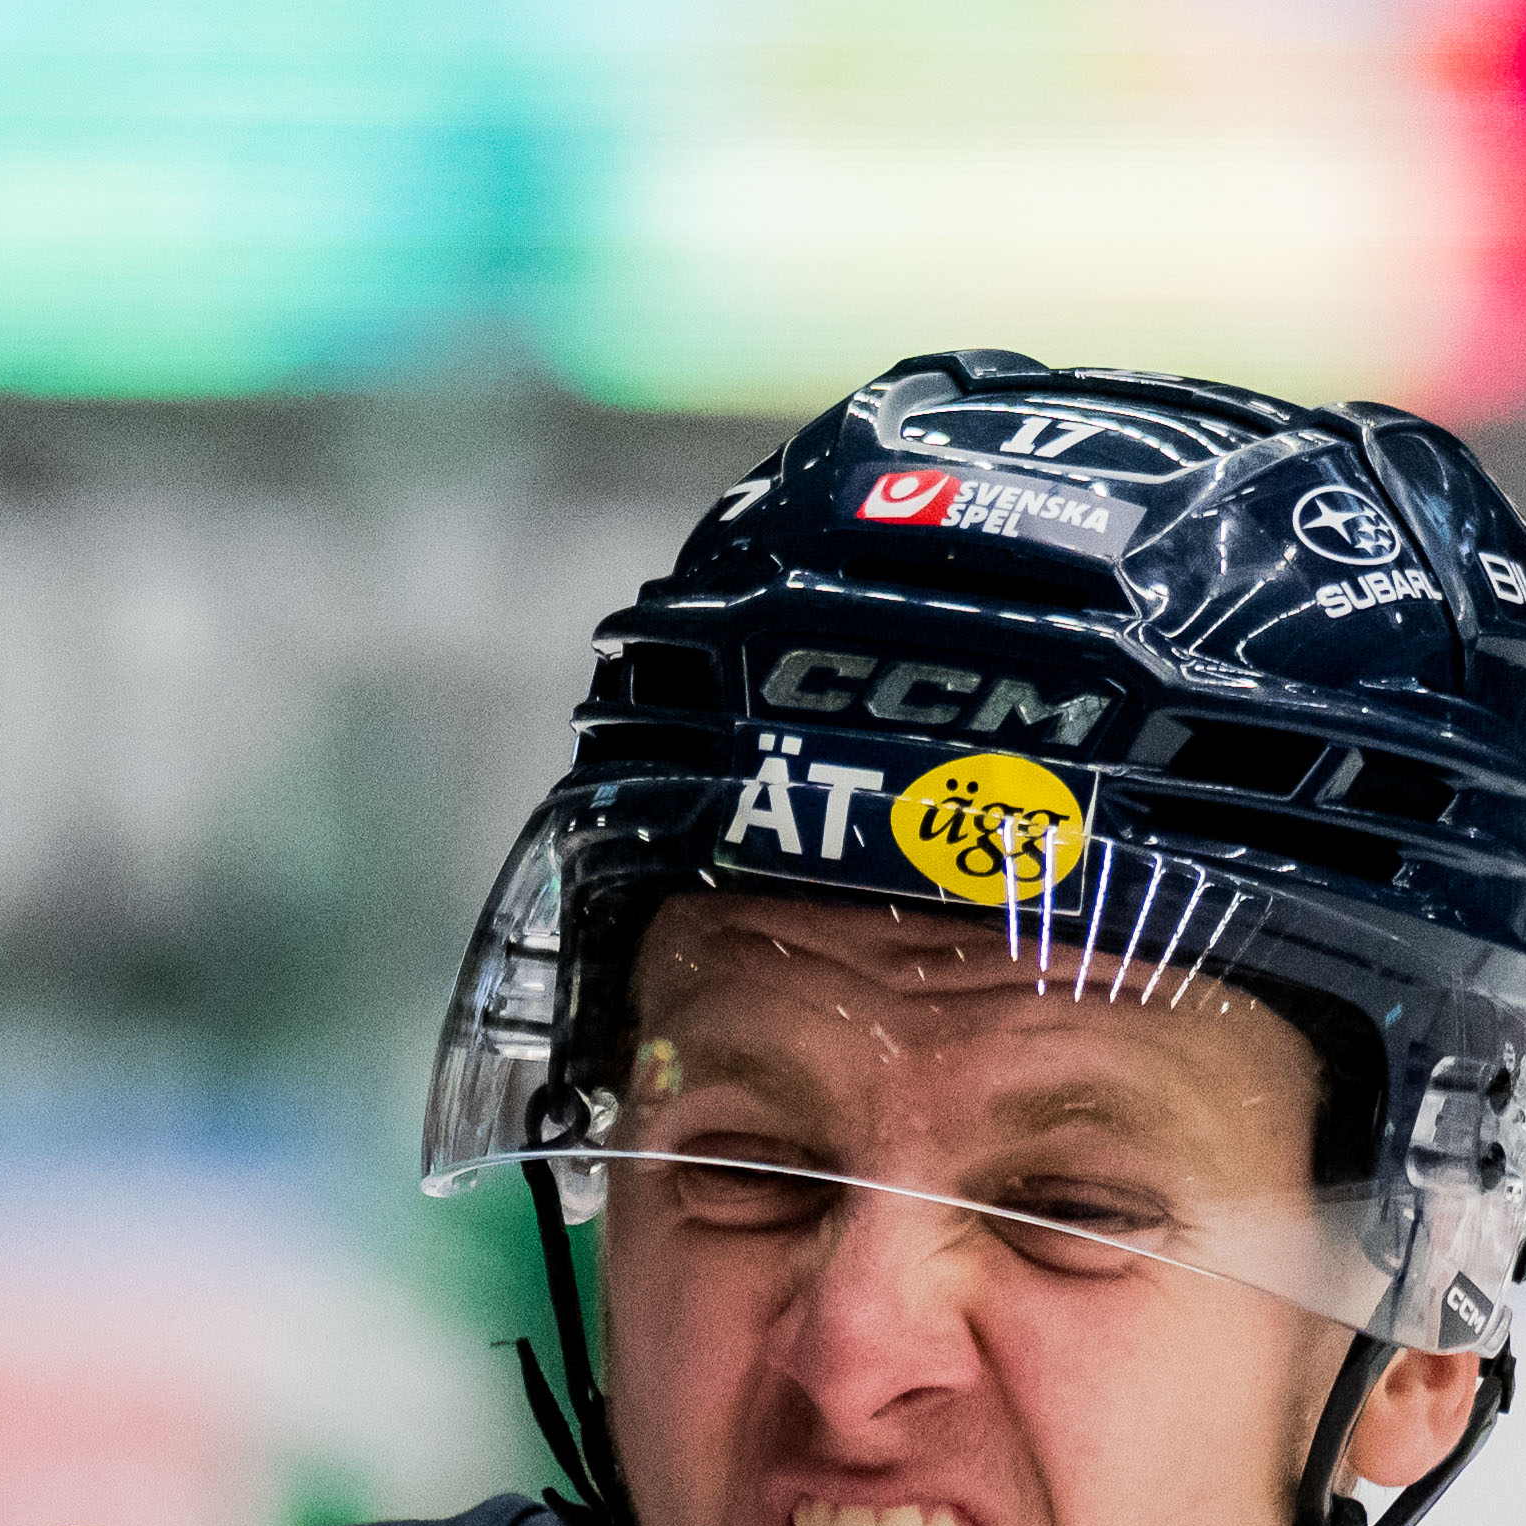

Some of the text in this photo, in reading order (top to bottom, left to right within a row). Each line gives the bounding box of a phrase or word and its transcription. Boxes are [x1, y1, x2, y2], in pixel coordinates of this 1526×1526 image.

[999, 416, 1107, 459] 17
[940, 502, 1024, 538] SPEL
[953, 480, 1112, 535] SVENSKA
[760, 648, 1113, 747] CCM
[724, 733, 884, 860] ÄT
[1447, 1286, 1487, 1335] CCM
